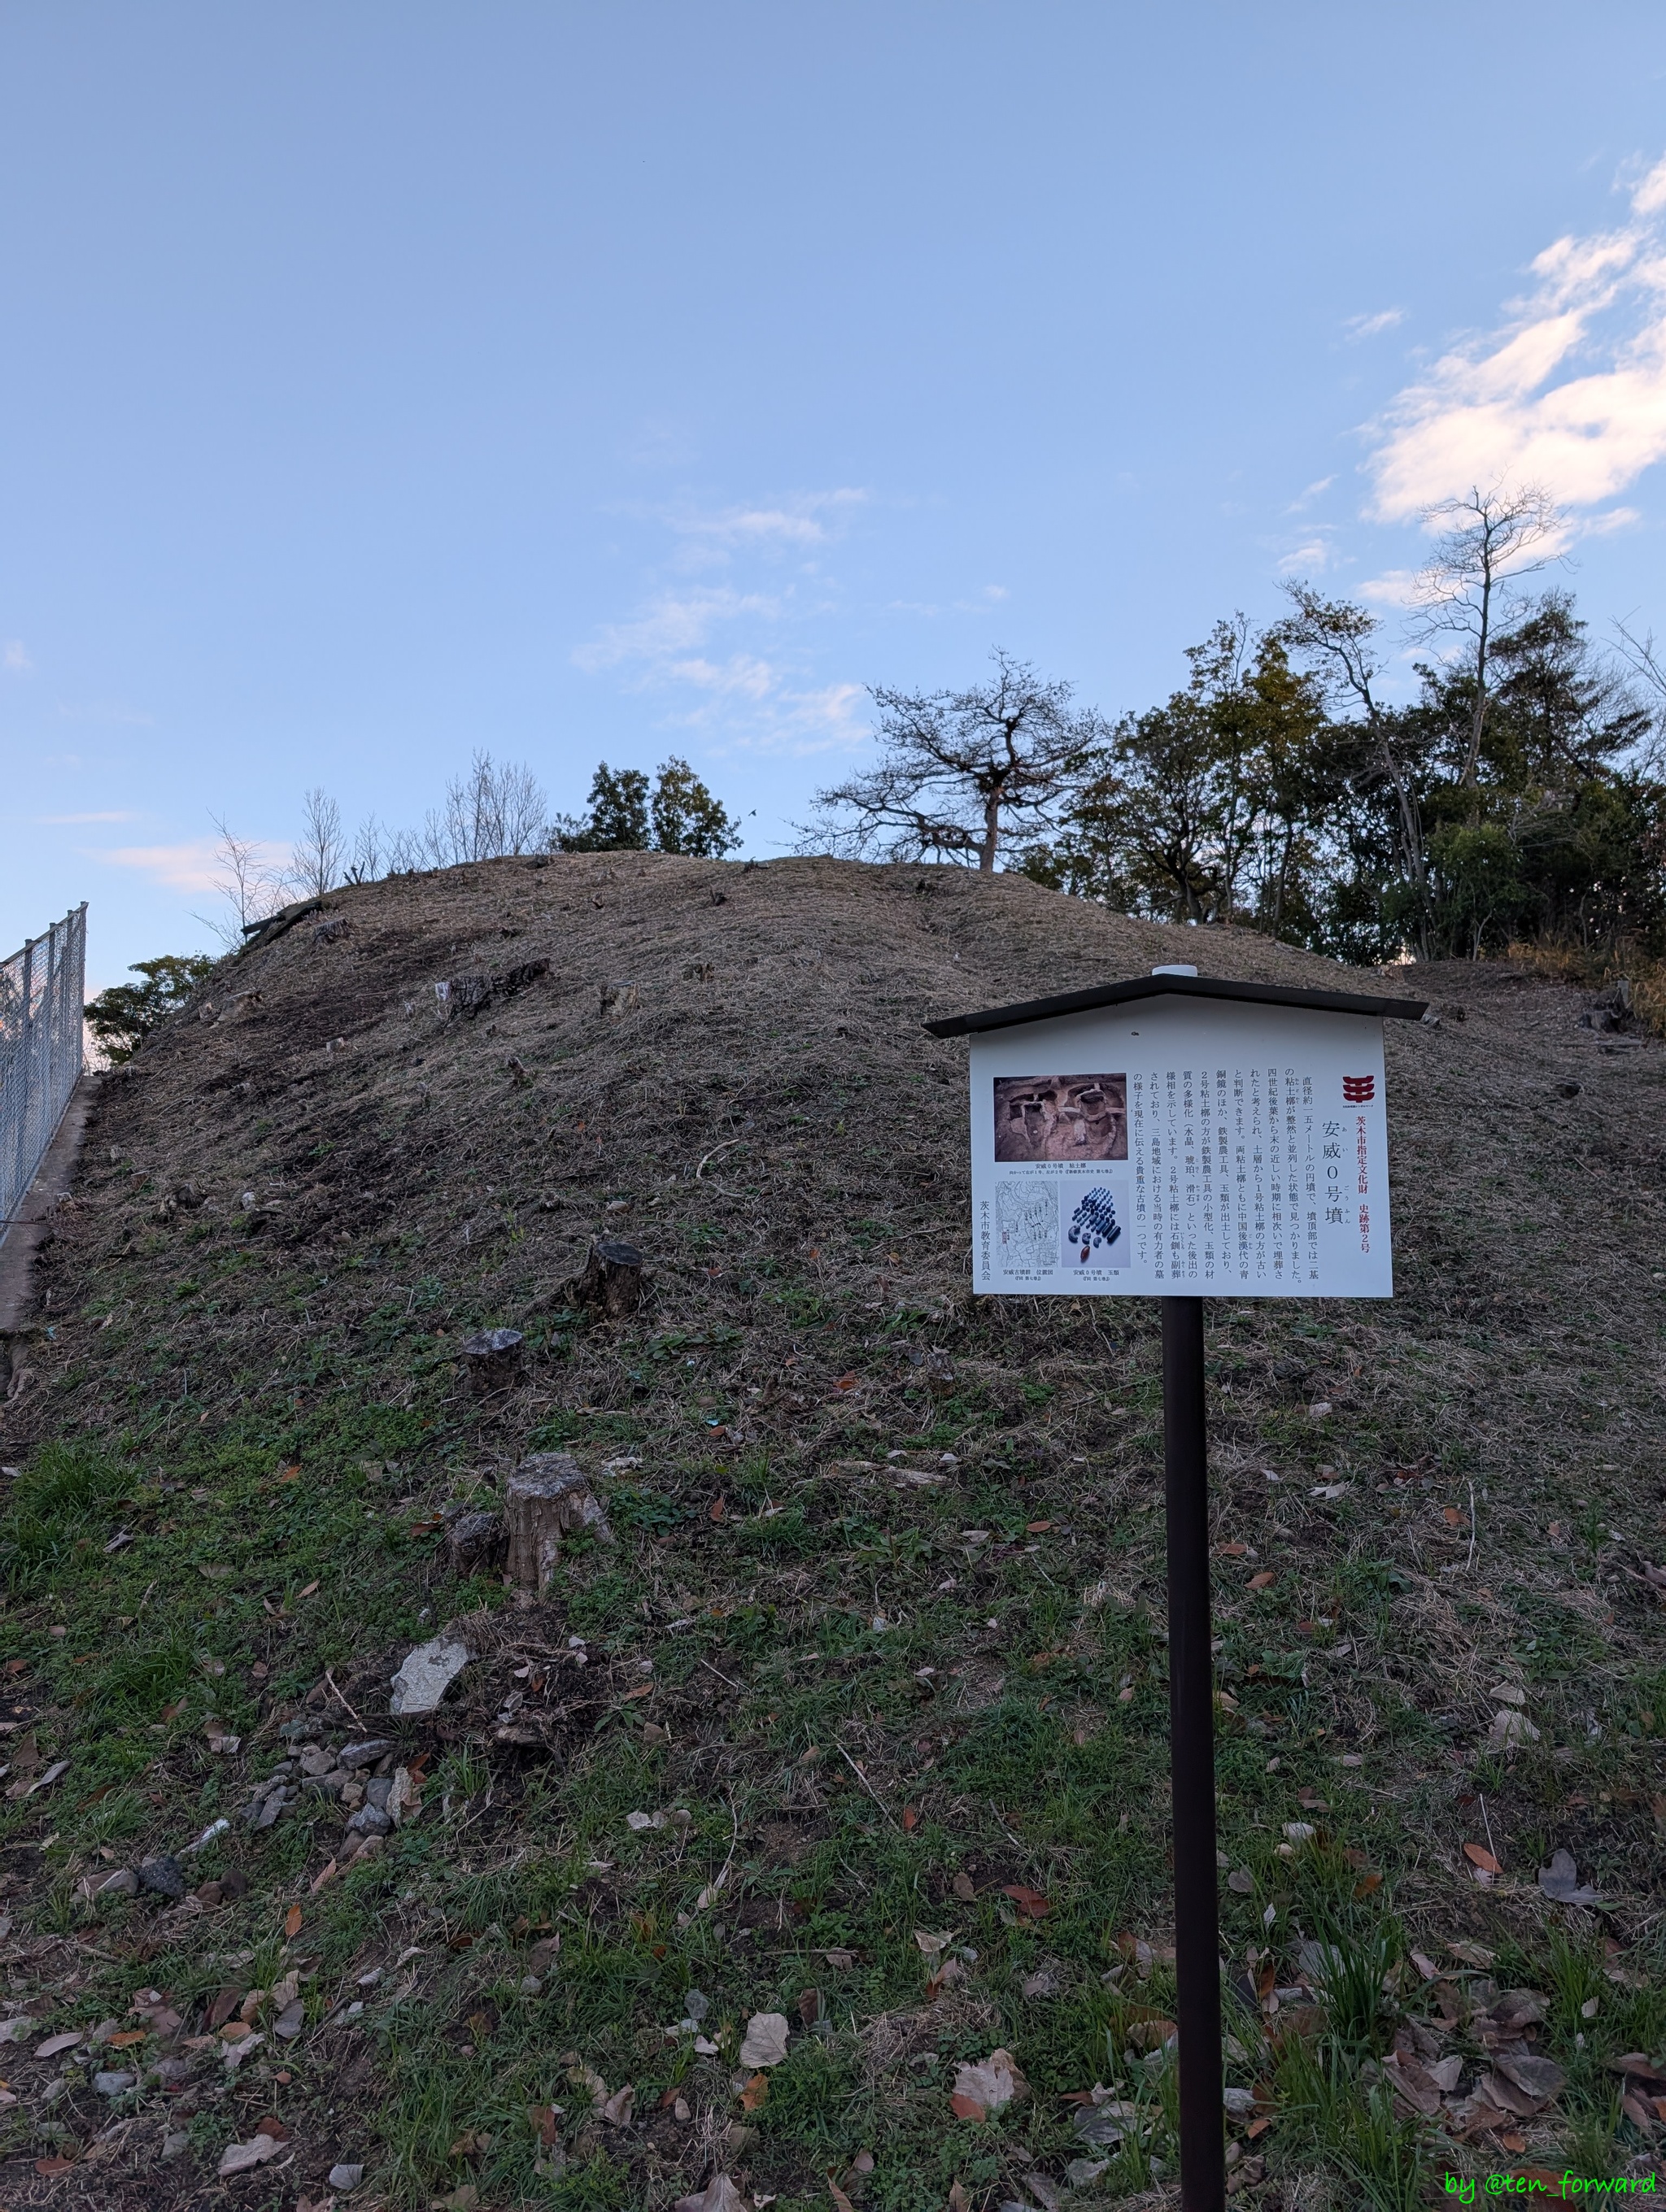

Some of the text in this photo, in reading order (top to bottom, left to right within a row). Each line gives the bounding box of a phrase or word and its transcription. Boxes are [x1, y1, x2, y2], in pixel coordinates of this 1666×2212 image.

[979, 1200, 991, 1281] 茨木市教育委員会
[1133, 1073, 1147, 1264] の様子を現在に伝える貴重な古墳の一つです。
[1149, 1072, 1164, 1279] されており、三島地域における当時の有力者の墓
[1268, 1069, 1284, 1279] 四世紀後葉から末の近しい時期に相次いで埋葬さ
[1302, 1077, 1319, 1279] 直径約一五メートルの円墳で、墳頂部では二基
[1322, 1121, 1343, 1225] 安威0号墳
[1356, 1116, 1371, 1253] 茨木市指定文化財 史跡第2号
